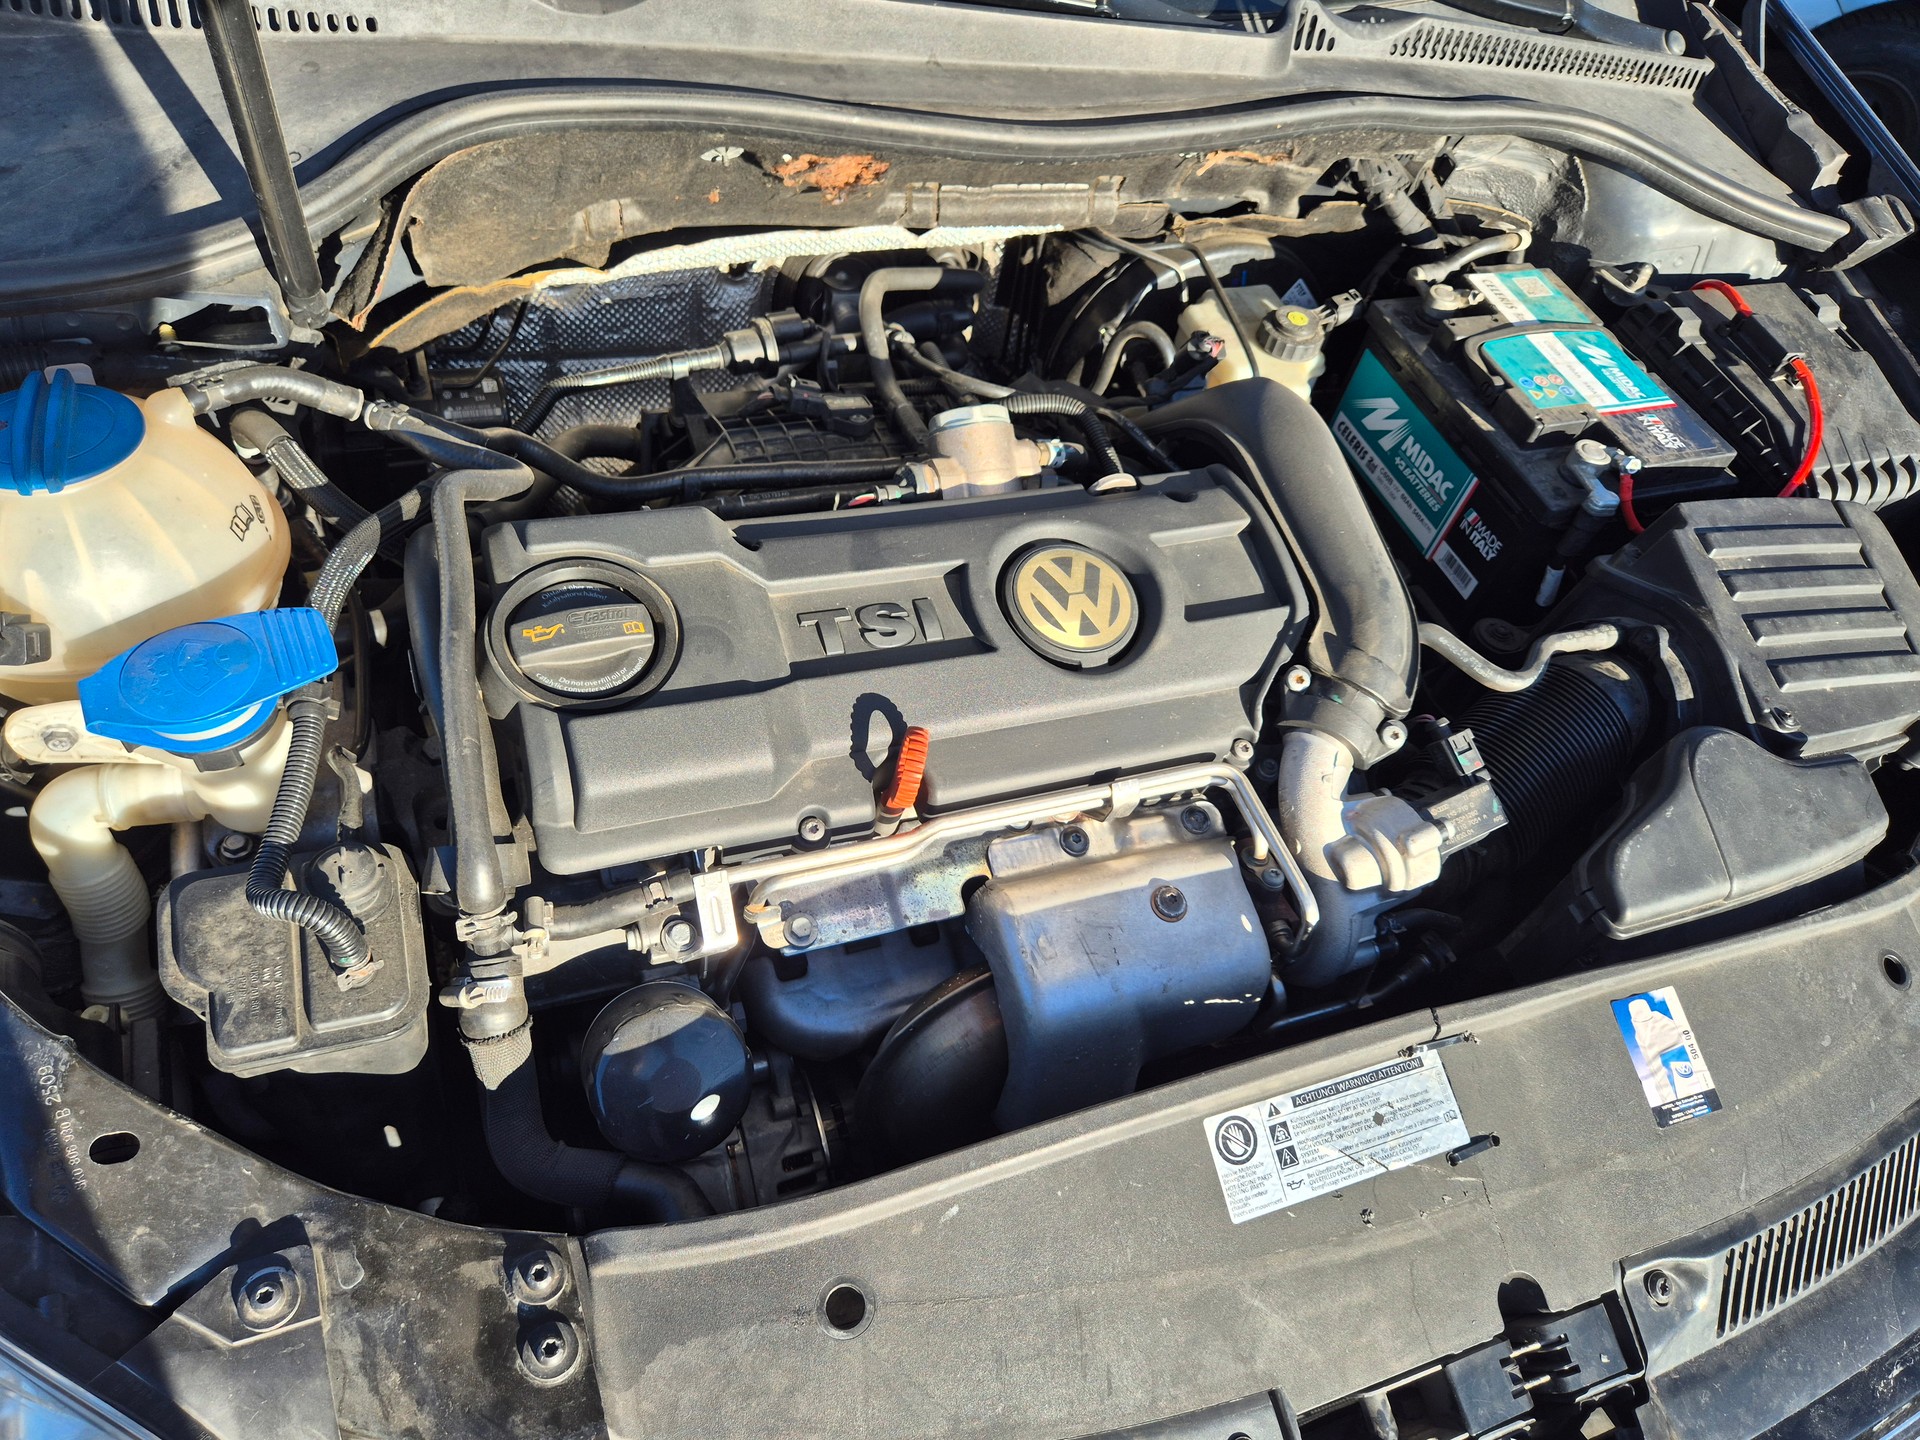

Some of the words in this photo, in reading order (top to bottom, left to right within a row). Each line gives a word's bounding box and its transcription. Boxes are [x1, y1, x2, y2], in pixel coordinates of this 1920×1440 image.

[1481, 277, 1516, 310] CELERIS
[1609, 368, 1647, 399] MIDAC
[1336, 420, 1368, 461] CELERIS
[1650, 429, 1677, 448] ITALY
[1654, 423, 1685, 448] MADE
[1401, 434, 1454, 501] MIDAC
[1402, 465, 1441, 513] BATTERIES
[1460, 518, 1480, 537] IN
[1474, 519, 1503, 551] MADE
[1469, 532, 1498, 562] ITALY
[583, 608, 629, 622] Castrol
[797, 598, 944, 656] TSI
[536, 672, 564, 691] catalytic
[564, 685, 598, 693] converter
[599, 681, 613, 691] will
[621, 657, 645, 682] damaged!
[559, 676, 571, 684] Do
[571, 680, 584, 688] not
[585, 676, 610, 688] overfill
[611, 671, 620, 681] oil
[1681, 1028, 1691, 1041] 00
[1687, 1042, 1699, 1060] 504
[38, 1064, 62, 1106] 2509
[1295, 1086, 1335, 1105] ACHTUNG!
[1337, 1073, 1376, 1091] WARNING!
[1378, 1058, 1420, 1078] ATTENTION!
[55, 1107, 71, 1120] B
[1292, 1118, 1315, 1129] RADIATOR
[60, 1121, 75, 1143] 930
[1299, 1143, 1313, 1151] HIGH
[1336, 1130, 1354, 1139] SWITCH
[65, 1144, 81, 1166] 806
[1300, 1148, 1319, 1157] SYSTEM
[1303, 1155, 1317, 1164] Haute
[1377, 1132, 1389, 1140] avant
[1309, 1172, 1336, 1184] OVERFILLED
[1337, 1165, 1354, 1175] ENGINE
[1378, 1151, 1398, 1161] DAMAGE
[1227, 1187, 1248, 1197] MOVING
[1250, 1182, 1265, 1190] PARTS
[1238, 1178, 1256, 1187] ENGINE
[1257, 1173, 1272, 1181] PARTS
